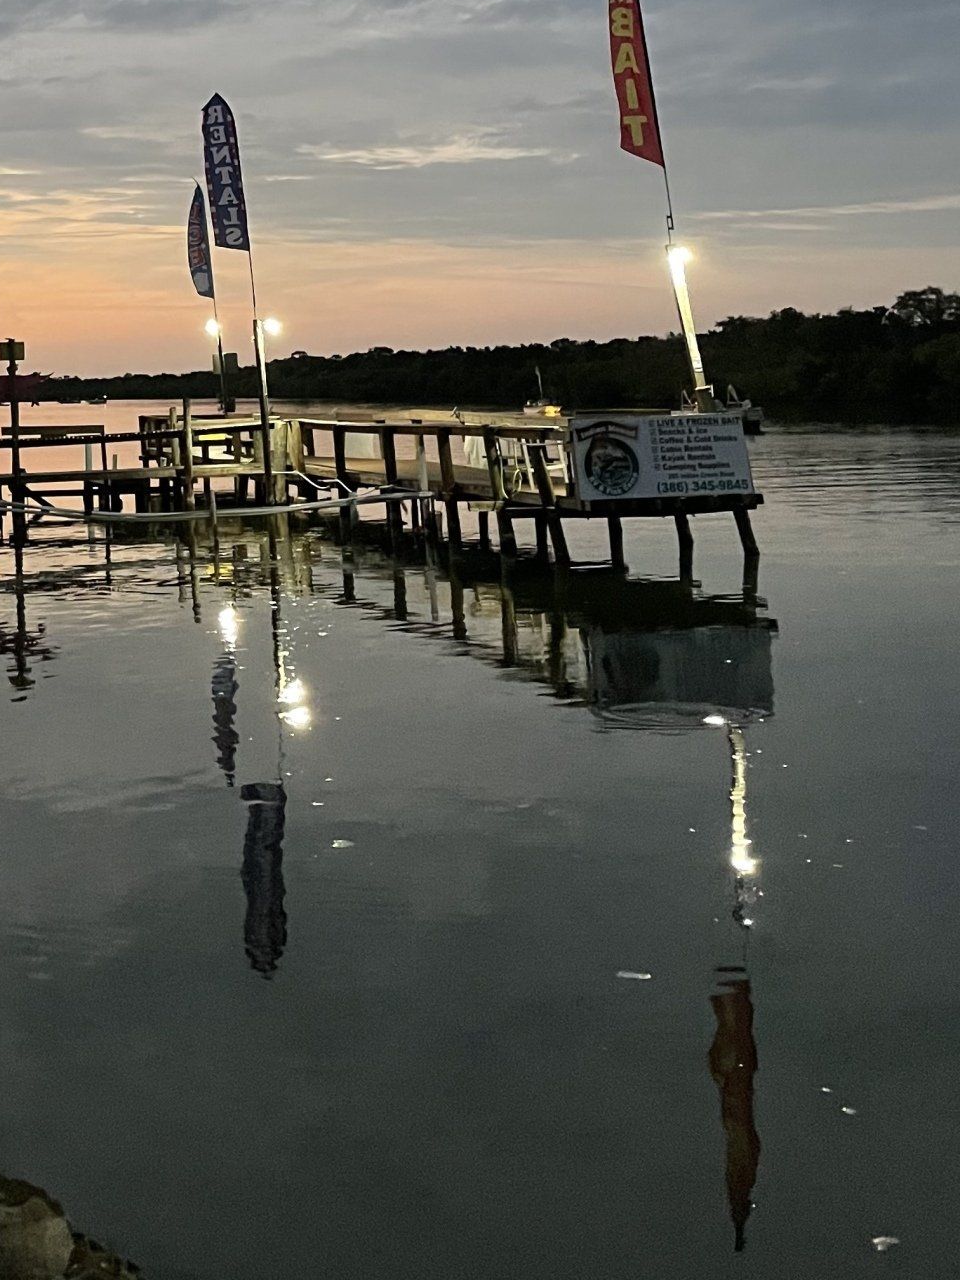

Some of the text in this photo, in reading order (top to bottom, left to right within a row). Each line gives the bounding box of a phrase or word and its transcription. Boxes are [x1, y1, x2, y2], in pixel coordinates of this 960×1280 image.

[656, 419, 675, 427] LIVE
[686, 417, 719, 426] FROZEN
[691, 479, 749, 492] 345-9845
